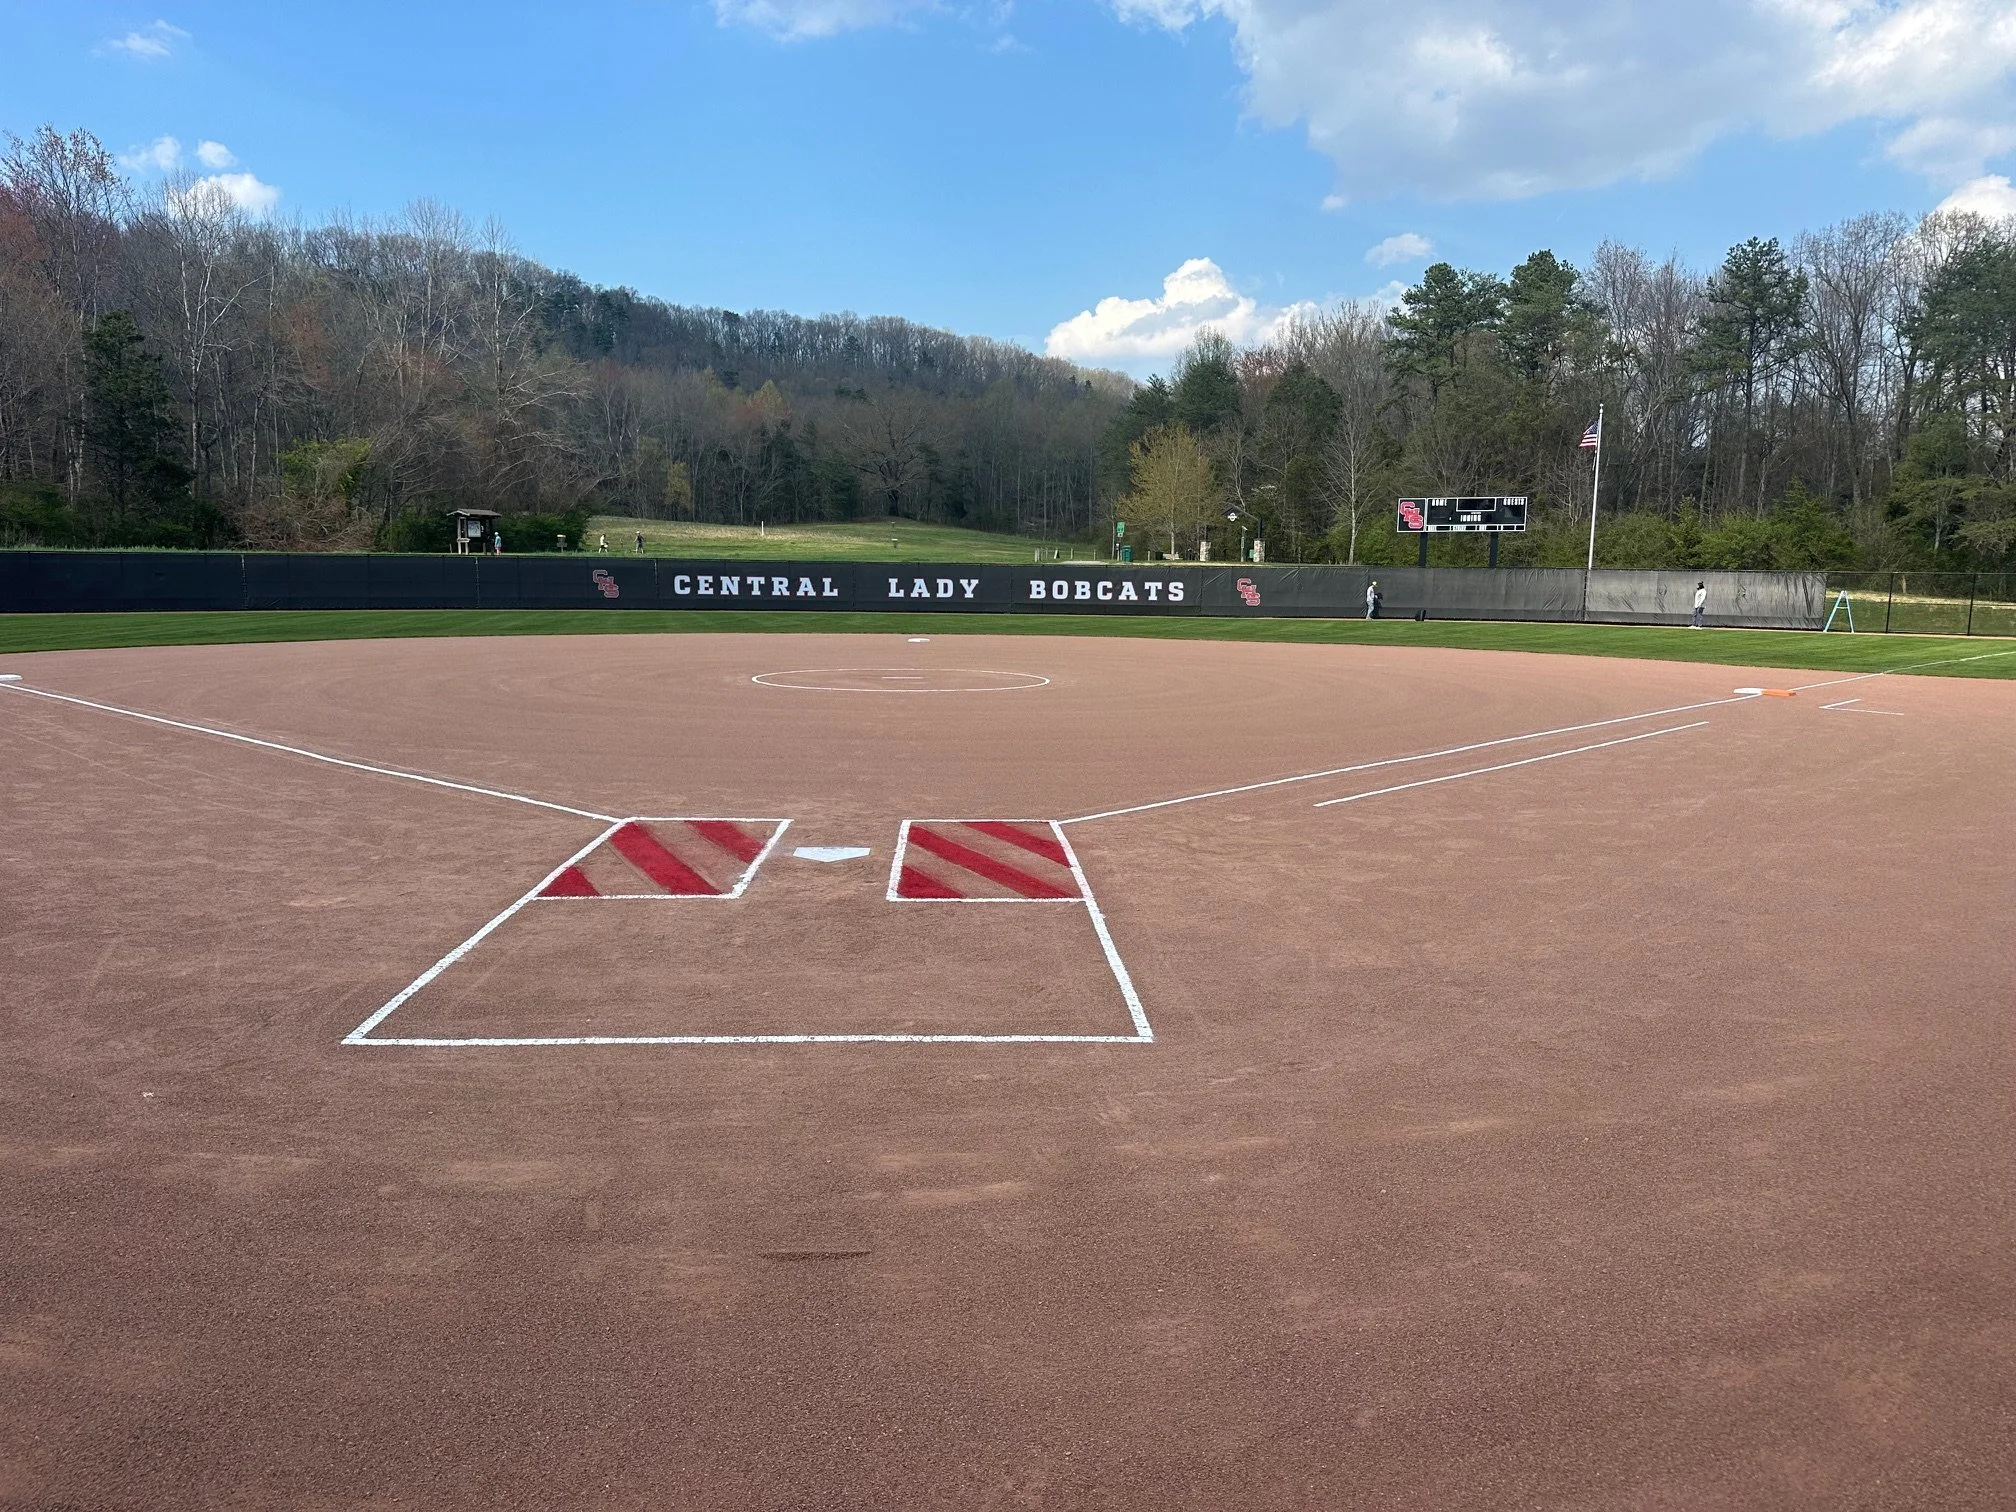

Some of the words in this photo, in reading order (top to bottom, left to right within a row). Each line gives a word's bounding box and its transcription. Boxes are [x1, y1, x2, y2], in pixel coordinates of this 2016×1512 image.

[673, 574, 839, 597] CENTRAL
[888, 577, 979, 599] LADY
[1029, 579, 1185, 602] BOBCATS
